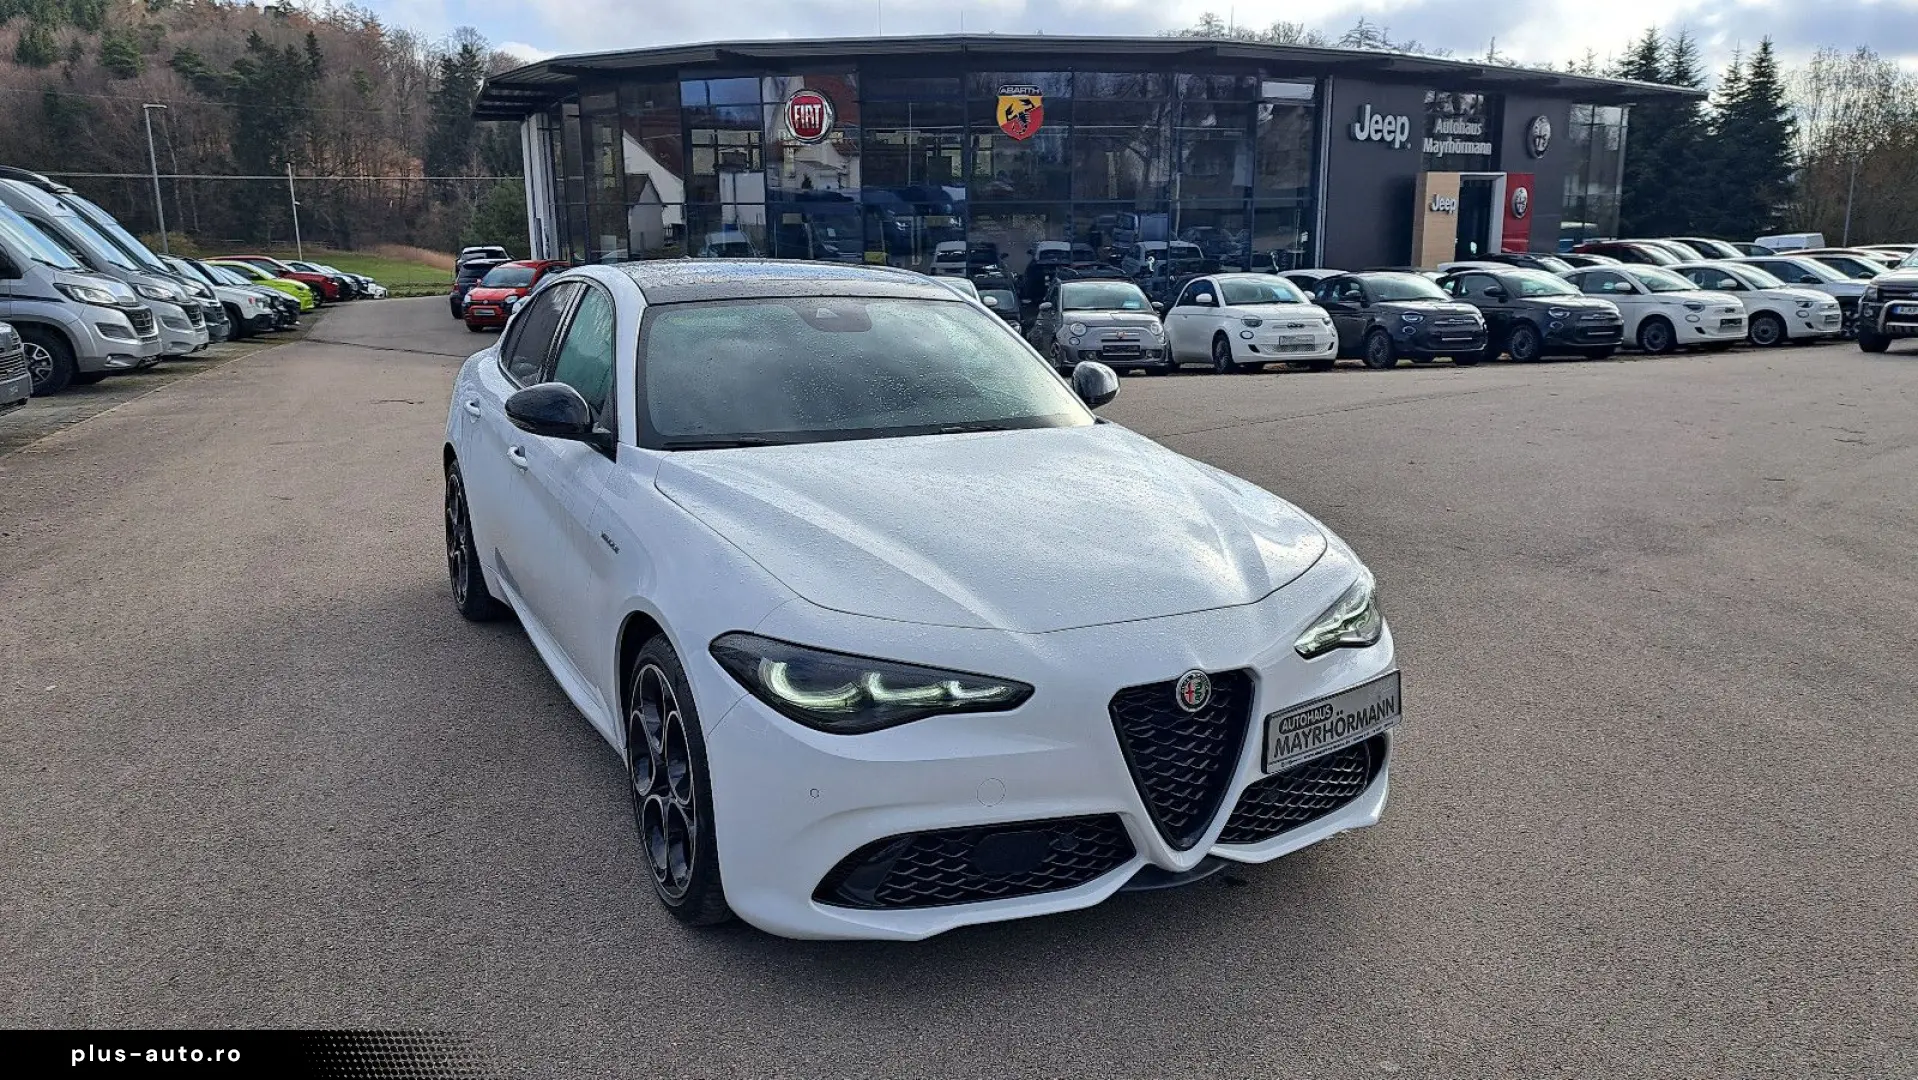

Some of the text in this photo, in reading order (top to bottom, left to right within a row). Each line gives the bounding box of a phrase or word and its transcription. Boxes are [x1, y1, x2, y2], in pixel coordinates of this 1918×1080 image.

[1000, 86, 1041, 95] ABARTH
[794, 104, 822, 129] FIAT
[1355, 103, 1410, 149] Jeep
[1434, 117, 1483, 135] Autohaus
[1423, 137, 1492, 158] Mayrhörmann
[1431, 193, 1457, 215] Jeep
[1273, 695, 1395, 758] MAYRHÖRMANN
[1281, 705, 1332, 732] AUTOHAUS
